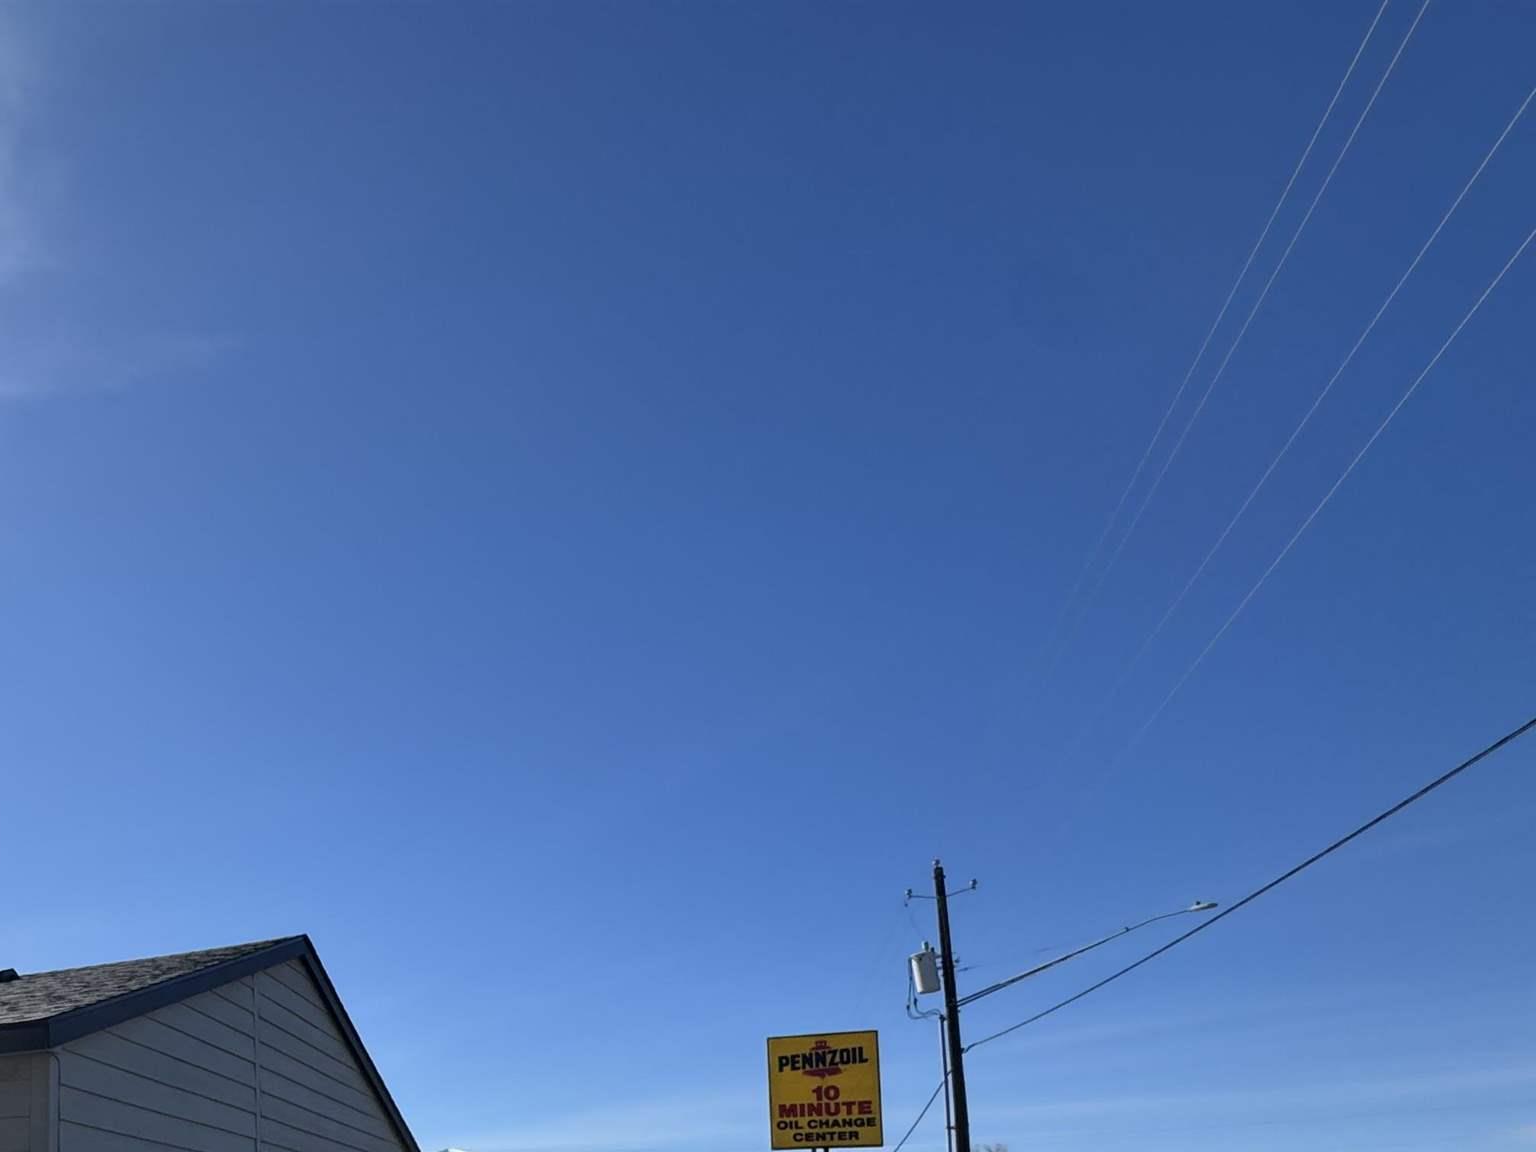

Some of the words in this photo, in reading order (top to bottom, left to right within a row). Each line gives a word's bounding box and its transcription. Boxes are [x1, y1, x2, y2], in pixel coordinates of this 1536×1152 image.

[778, 1046, 869, 1072] PENNZOIL
[812, 1085, 840, 1101] 10
[778, 1101, 873, 1118] MINUTE
[777, 1119, 804, 1130] OIL
[807, 1117, 876, 1129] CHANGE
[793, 1130, 860, 1142] CENTER
